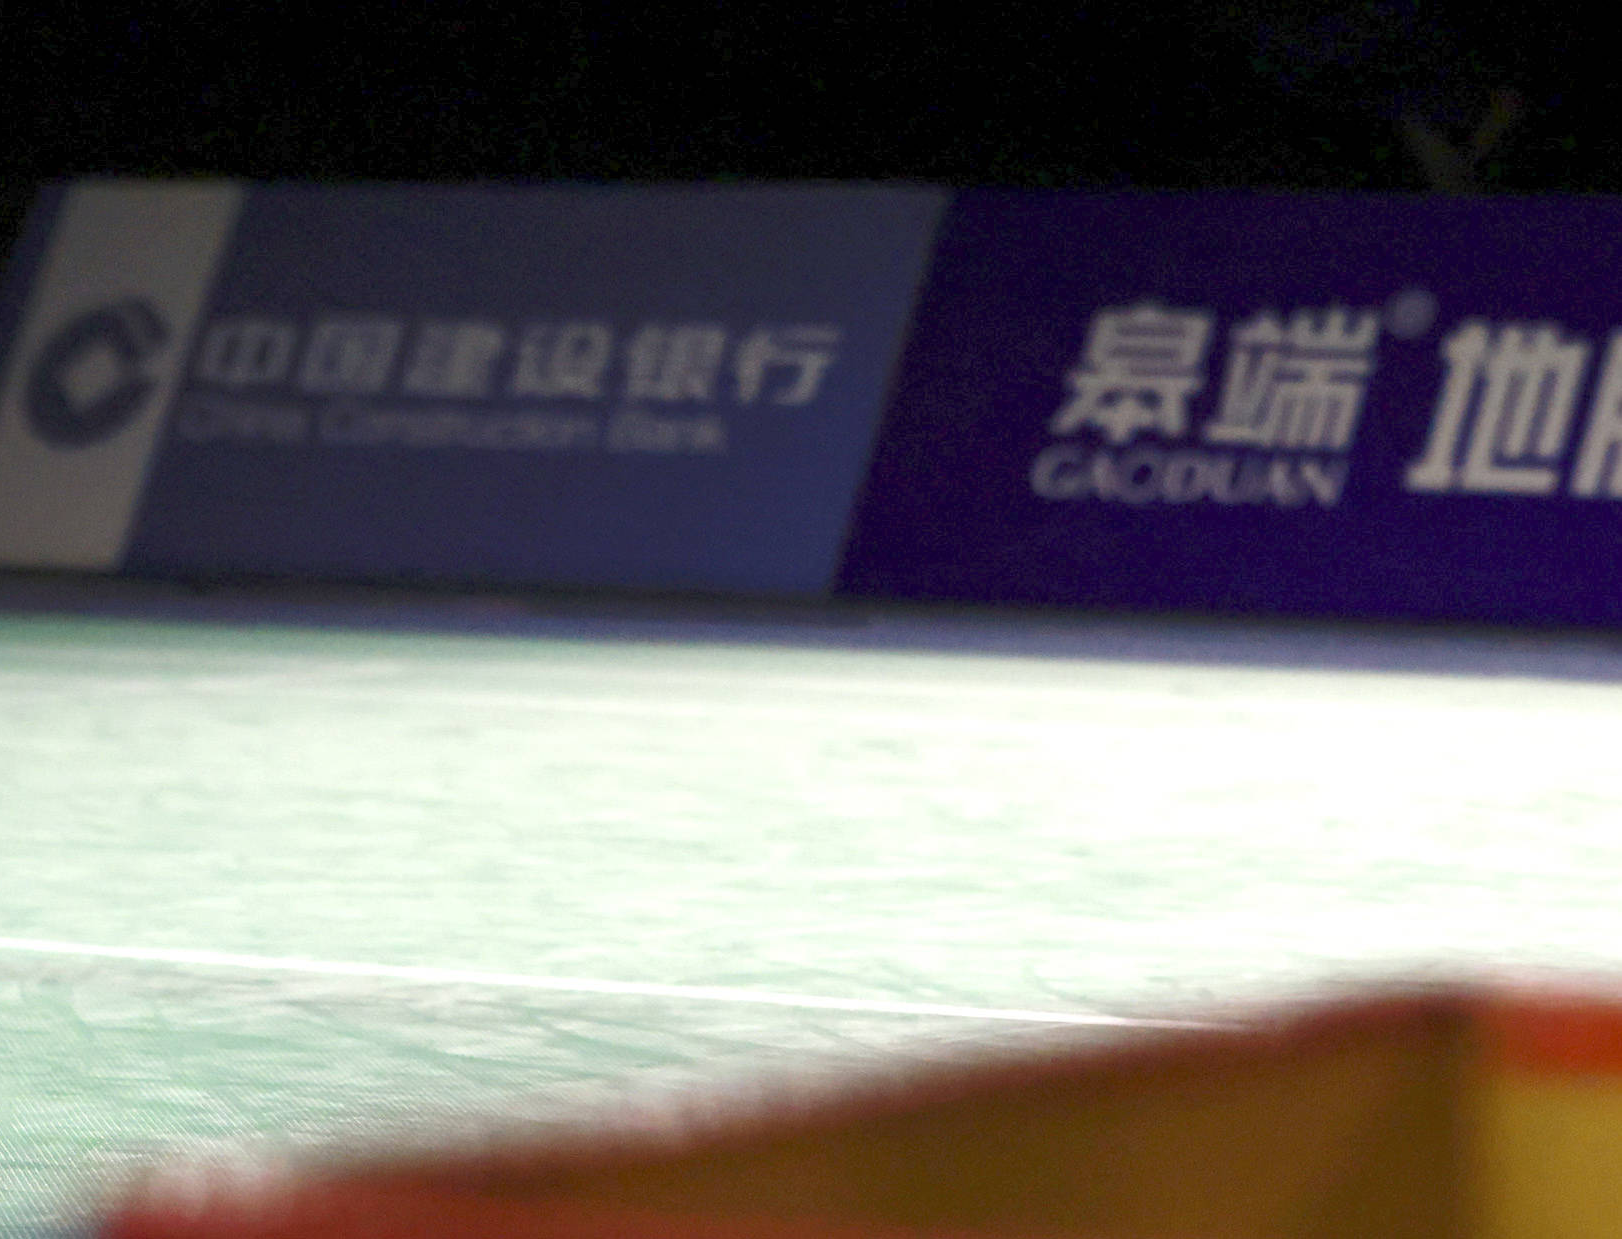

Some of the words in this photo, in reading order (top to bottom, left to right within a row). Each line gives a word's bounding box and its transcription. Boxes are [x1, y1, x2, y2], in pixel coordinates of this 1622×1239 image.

[197, 318, 844, 408] 中国建设银行
